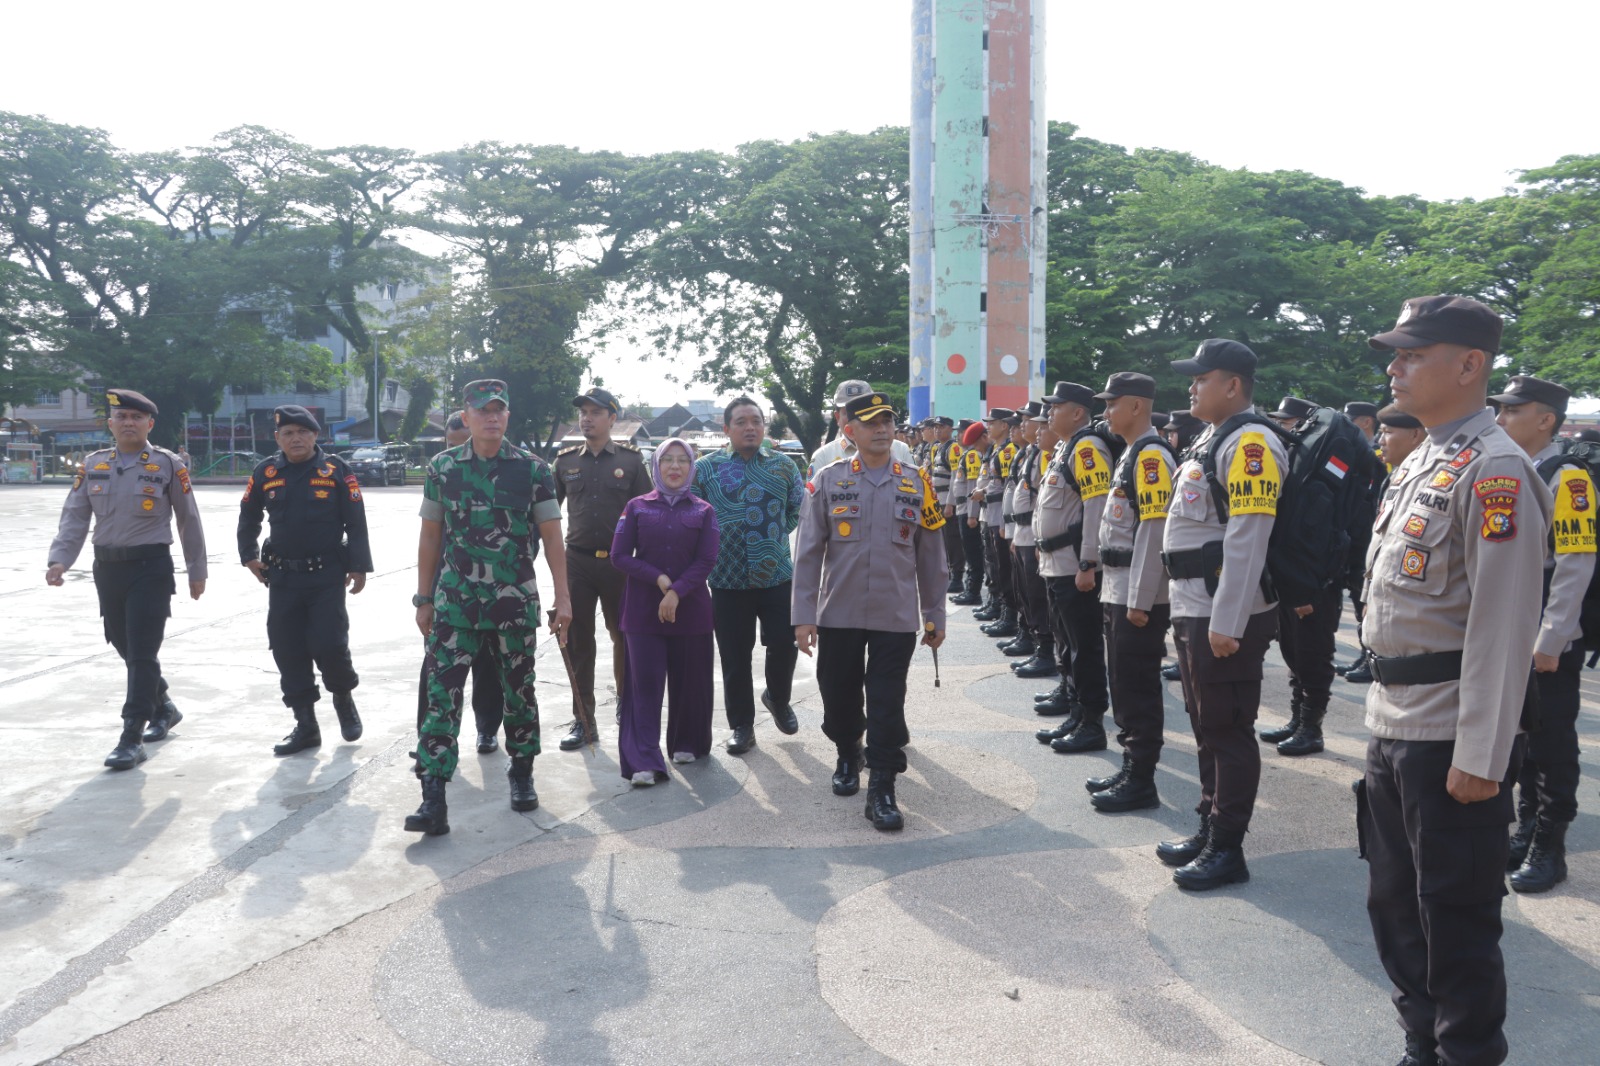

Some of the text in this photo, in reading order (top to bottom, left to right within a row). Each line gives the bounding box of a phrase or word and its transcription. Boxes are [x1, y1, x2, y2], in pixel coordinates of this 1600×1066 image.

[138, 475, 163, 485] POLRI
[1095, 471, 1109, 483] TPS
[1229, 479, 1277, 498] PAM TPS
[1476, 478, 1517, 491] POLRES
[831, 492, 860, 502] DODY
[895, 494, 920, 507] POLRI
[1138, 491, 1153, 506] AM
[1242, 497, 1251, 507] LK
[1414, 491, 1450, 512] POLRI
[1485, 496, 1513, 505] RIAU
[1554, 518, 1581, 536] PAM
[1571, 535, 1581, 546] LK
